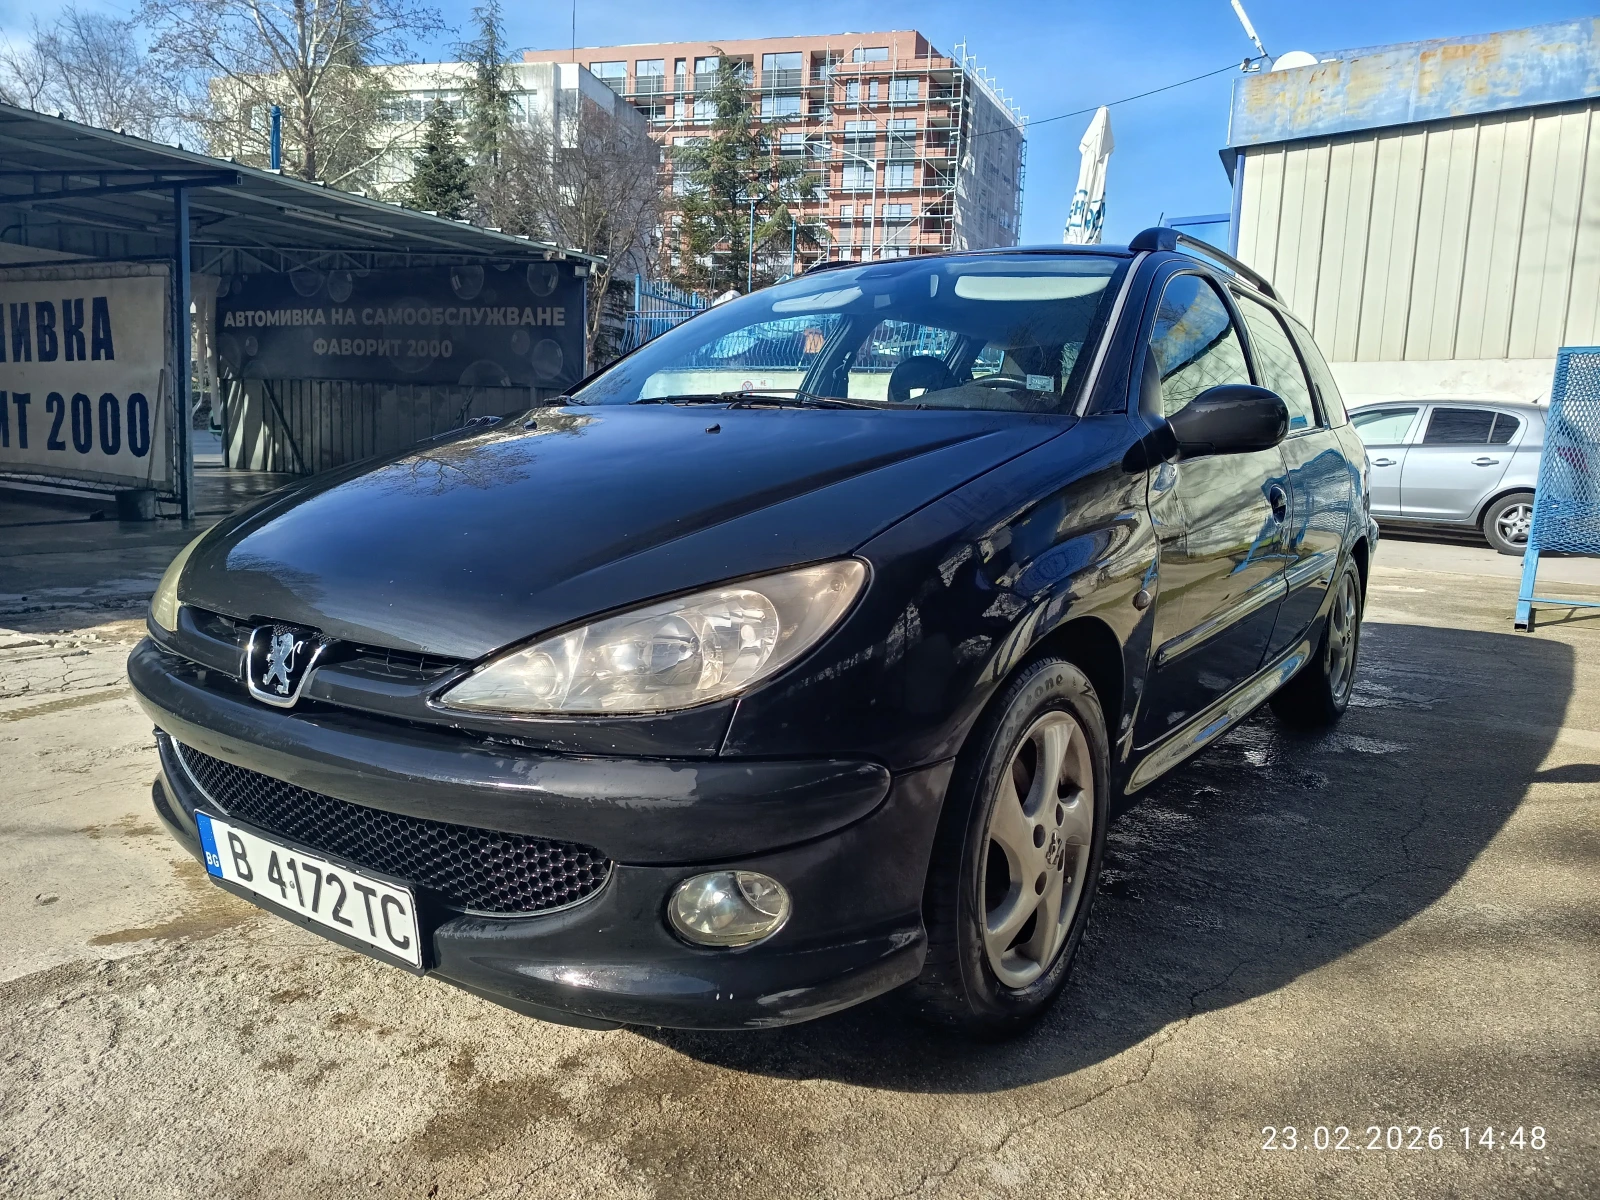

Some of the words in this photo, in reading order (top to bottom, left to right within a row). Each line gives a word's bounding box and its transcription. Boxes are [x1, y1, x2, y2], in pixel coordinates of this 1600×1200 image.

[224, 308, 326, 328] АВТОМИВКА
[331, 307, 357, 326] НА
[361, 306, 566, 326] САМООБСЛУЖВАНЕ
[0, 296, 115, 363] ИВКА
[312, 337, 401, 357] ФАВОРИТ
[407, 339, 453, 358] 2000
[45, 391, 151, 458] 2000
[205, 851, 220, 868] BG
